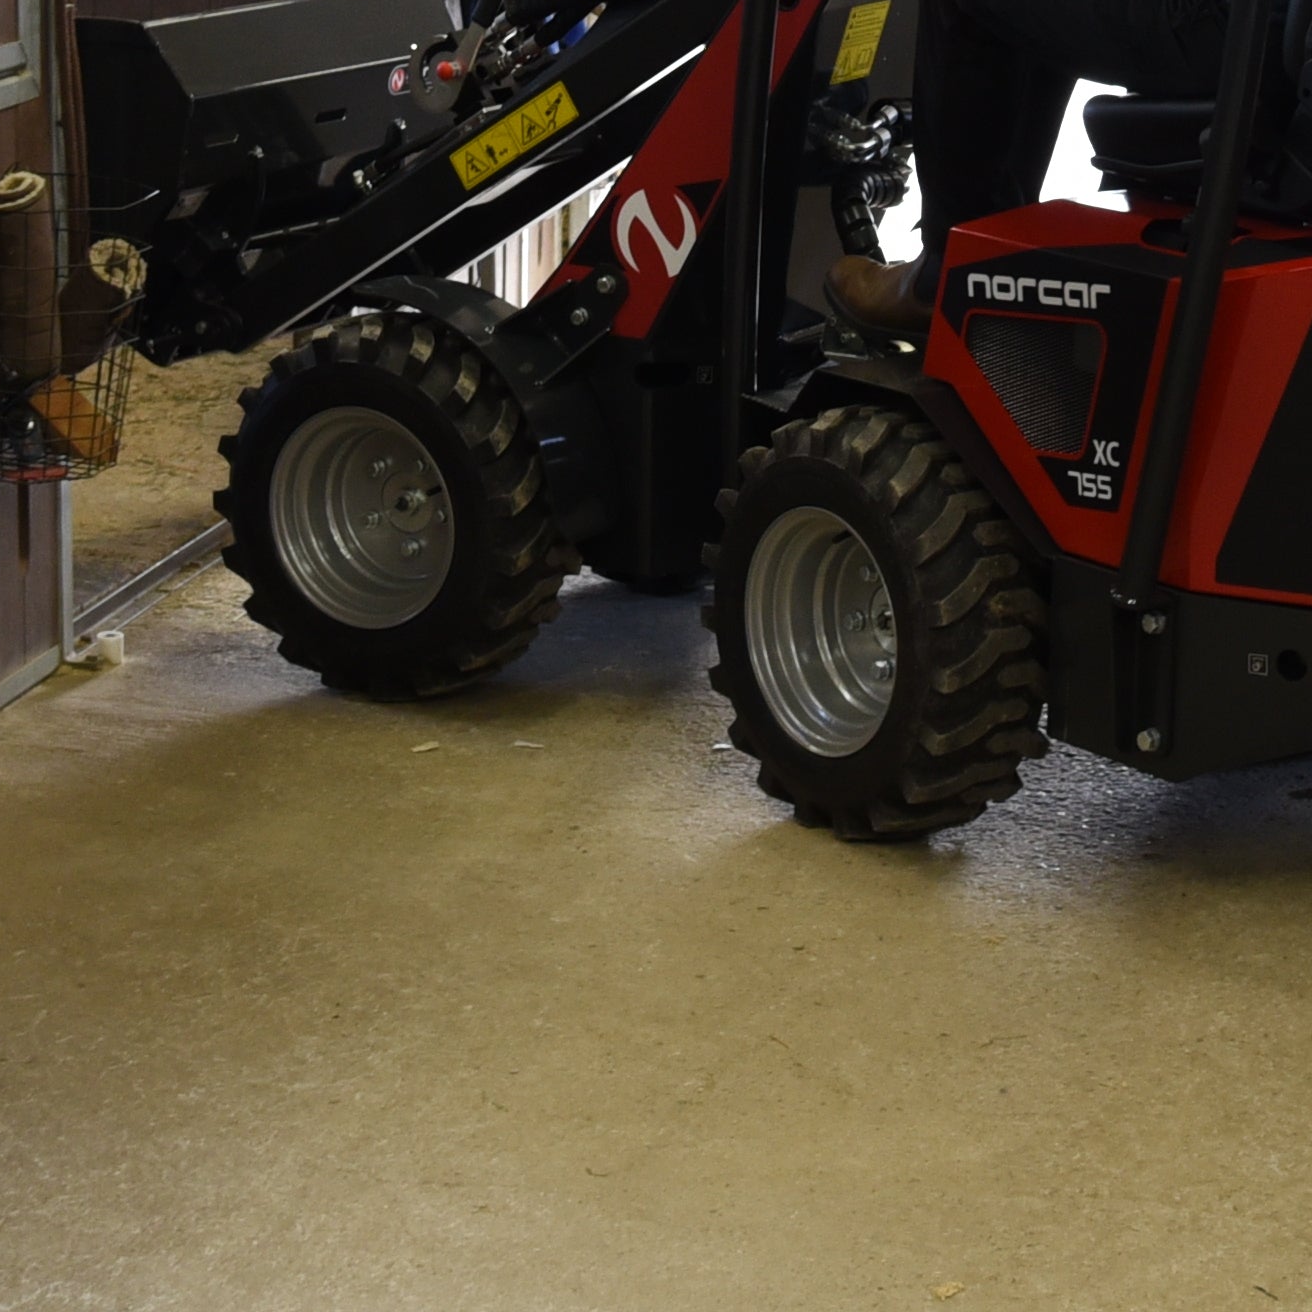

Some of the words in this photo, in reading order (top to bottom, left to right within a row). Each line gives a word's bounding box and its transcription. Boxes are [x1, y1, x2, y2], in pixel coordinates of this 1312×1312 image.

[967, 272, 1111, 309] norcar
[1092, 439, 1120, 467] XC
[1067, 470, 1112, 500] 755
